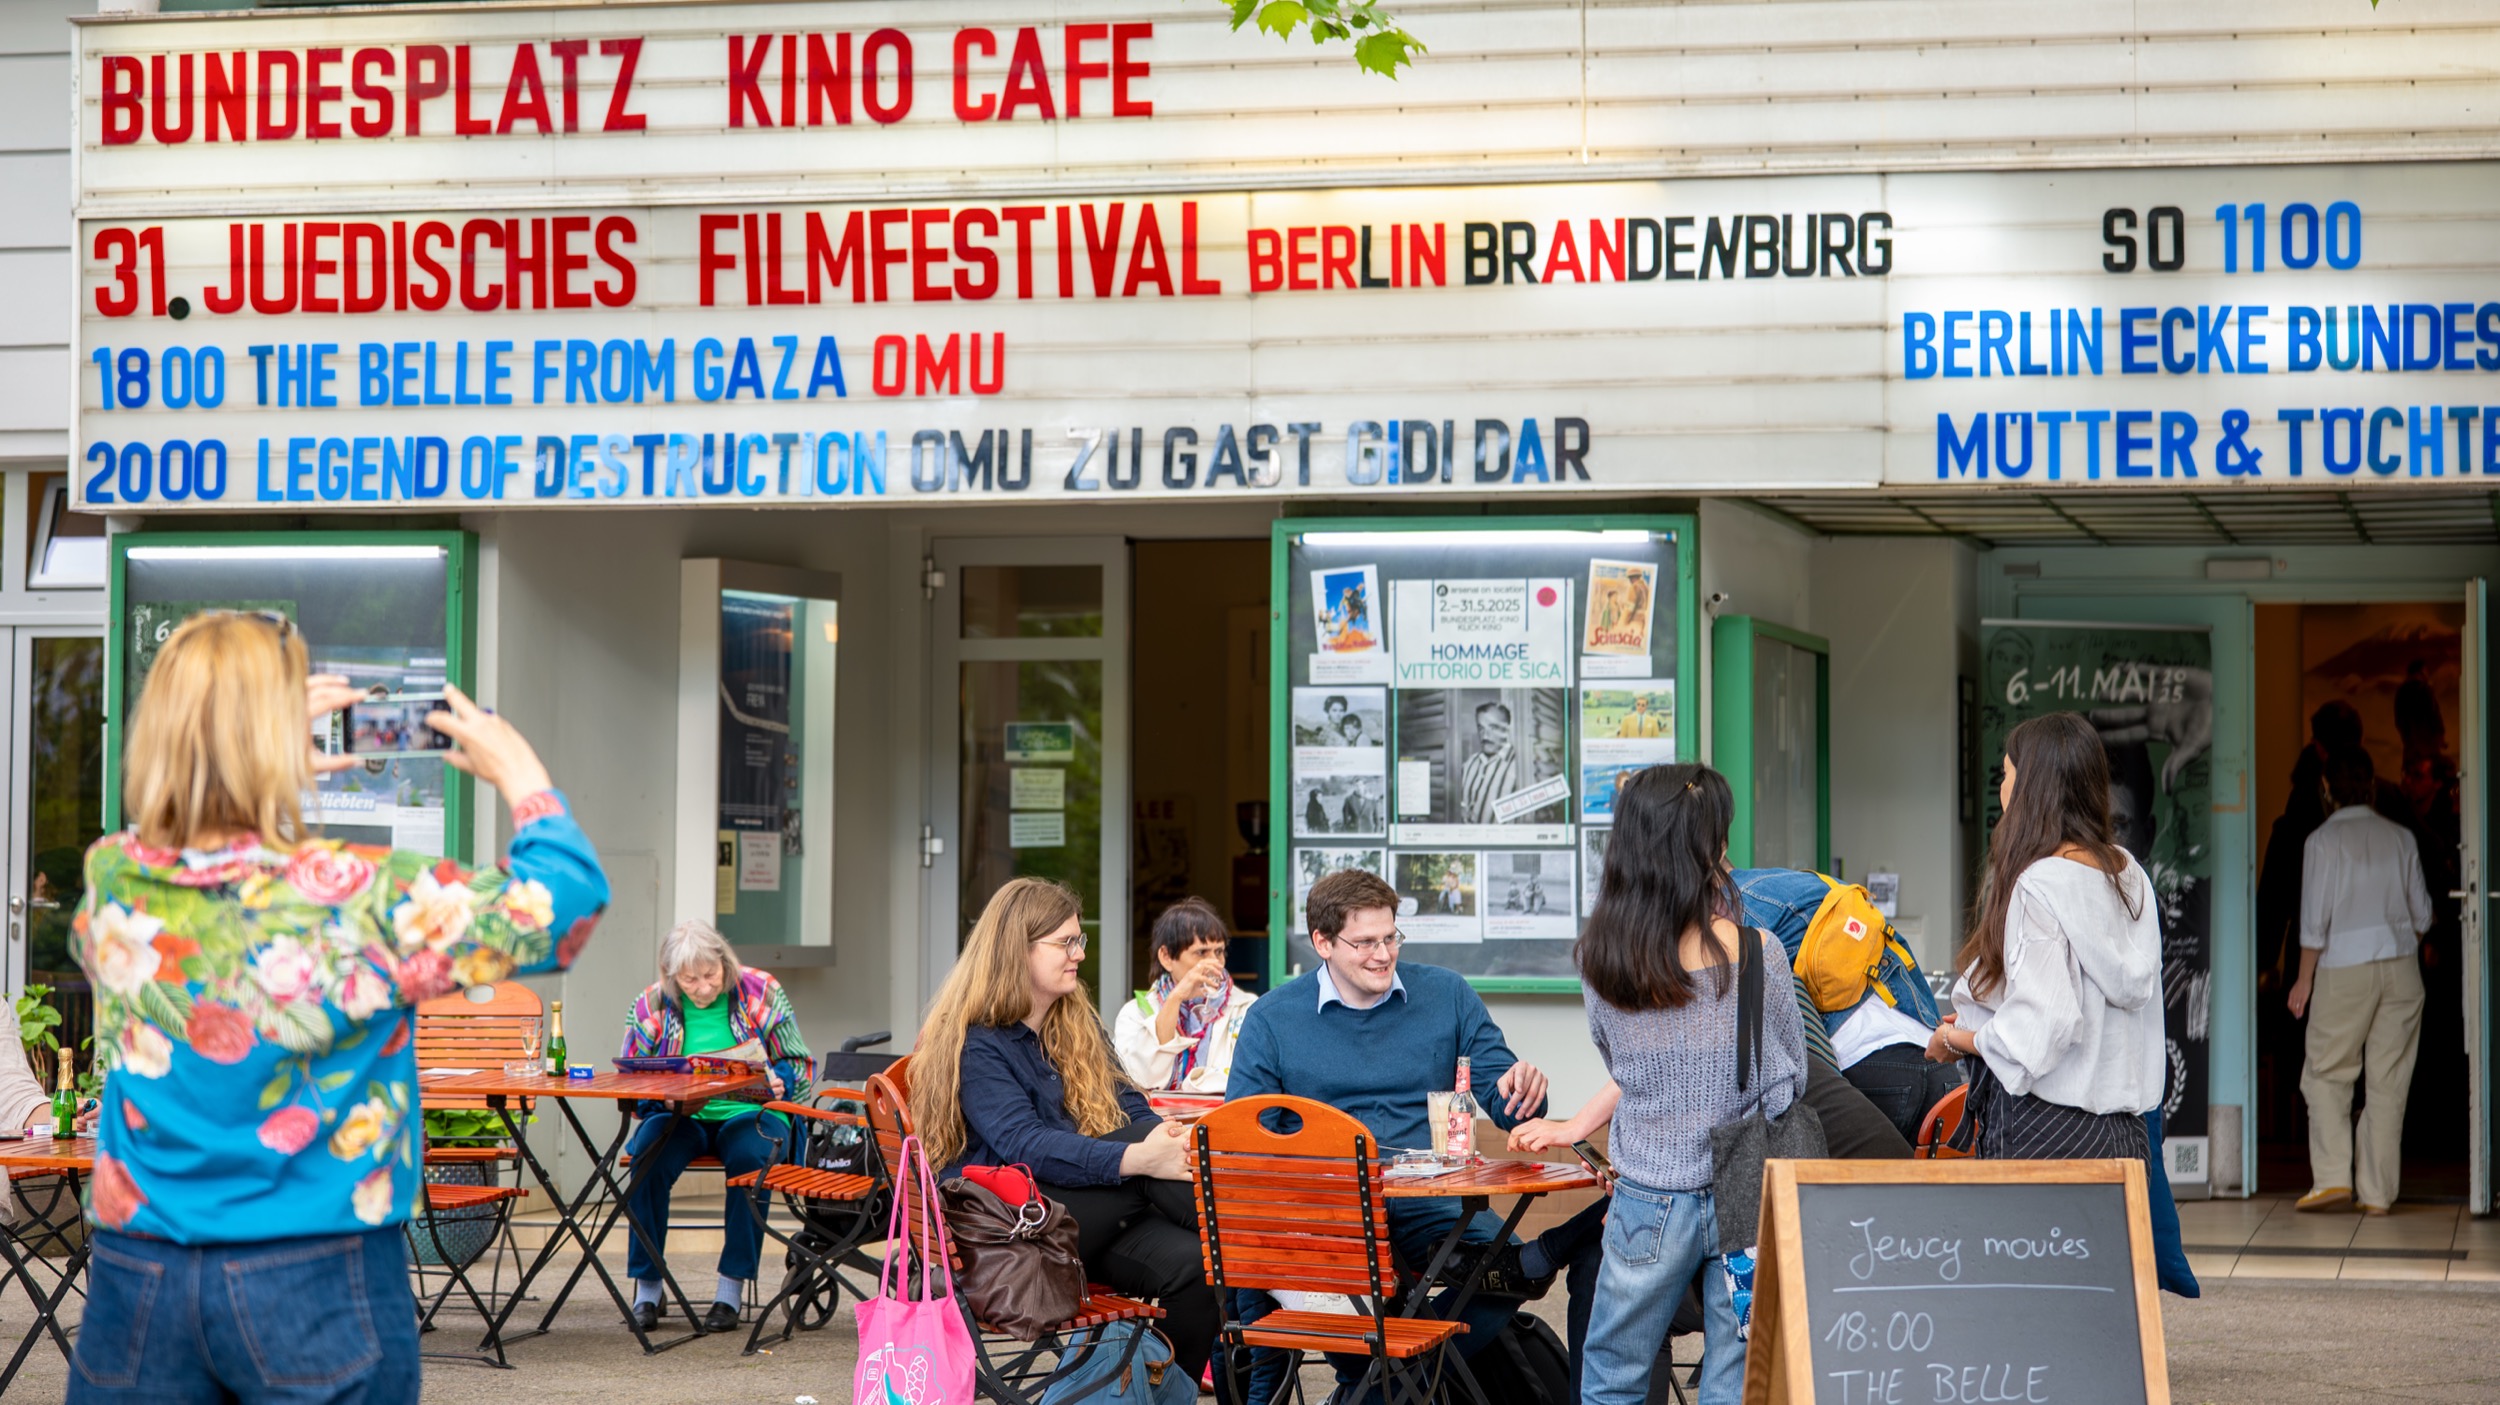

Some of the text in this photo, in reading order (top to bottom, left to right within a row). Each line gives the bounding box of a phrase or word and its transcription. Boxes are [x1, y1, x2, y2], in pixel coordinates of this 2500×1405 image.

[102, 22, 1153, 146] BUNDESPLATZ KINO CAFE
[93, 201, 1892, 320] 31. JUEDISCHES FILMFESTIVAL BERLIN BRANDENBURG
[2103, 206, 2185, 273] SO
[248, 343, 339, 409] THE
[360, 341, 512, 408] BELLE
[534, 338, 675, 405] FROM
[693, 335, 847, 403] GAZA
[872, 332, 1005, 397] OMU
[1904, 307, 2102, 380] BERLIN
[2121, 305, 2269, 374] ECKE
[258, 436, 449, 503] LEGEND
[460, 435, 522, 500] OF
[535, 430, 887, 500] DESTRUCTION
[911, 428, 1033, 493] OMU
[1064, 426, 1143, 491] ZU
[1162, 421, 1321, 489] GAST
[1346, 419, 1454, 486] GIDI
[1475, 417, 1592, 483] DAR
[1936, 409, 2199, 480] MÜTTER
[2216, 409, 2263, 476] &
[1451, 585, 1479, 594] arsenal
[1493, 585, 1525, 594] location
[1400, 661, 1561, 680] VITTORIO DE SICA
[1431, 644, 1529, 660] HOMMAGE
[2091, 663, 2155, 703] MAI
[1849, 1217, 2090, 1281] Jewcy movies
[1824, 1311, 1934, 1353] 18:00
[1829, 1364, 2049, 1405] THE BELLE
